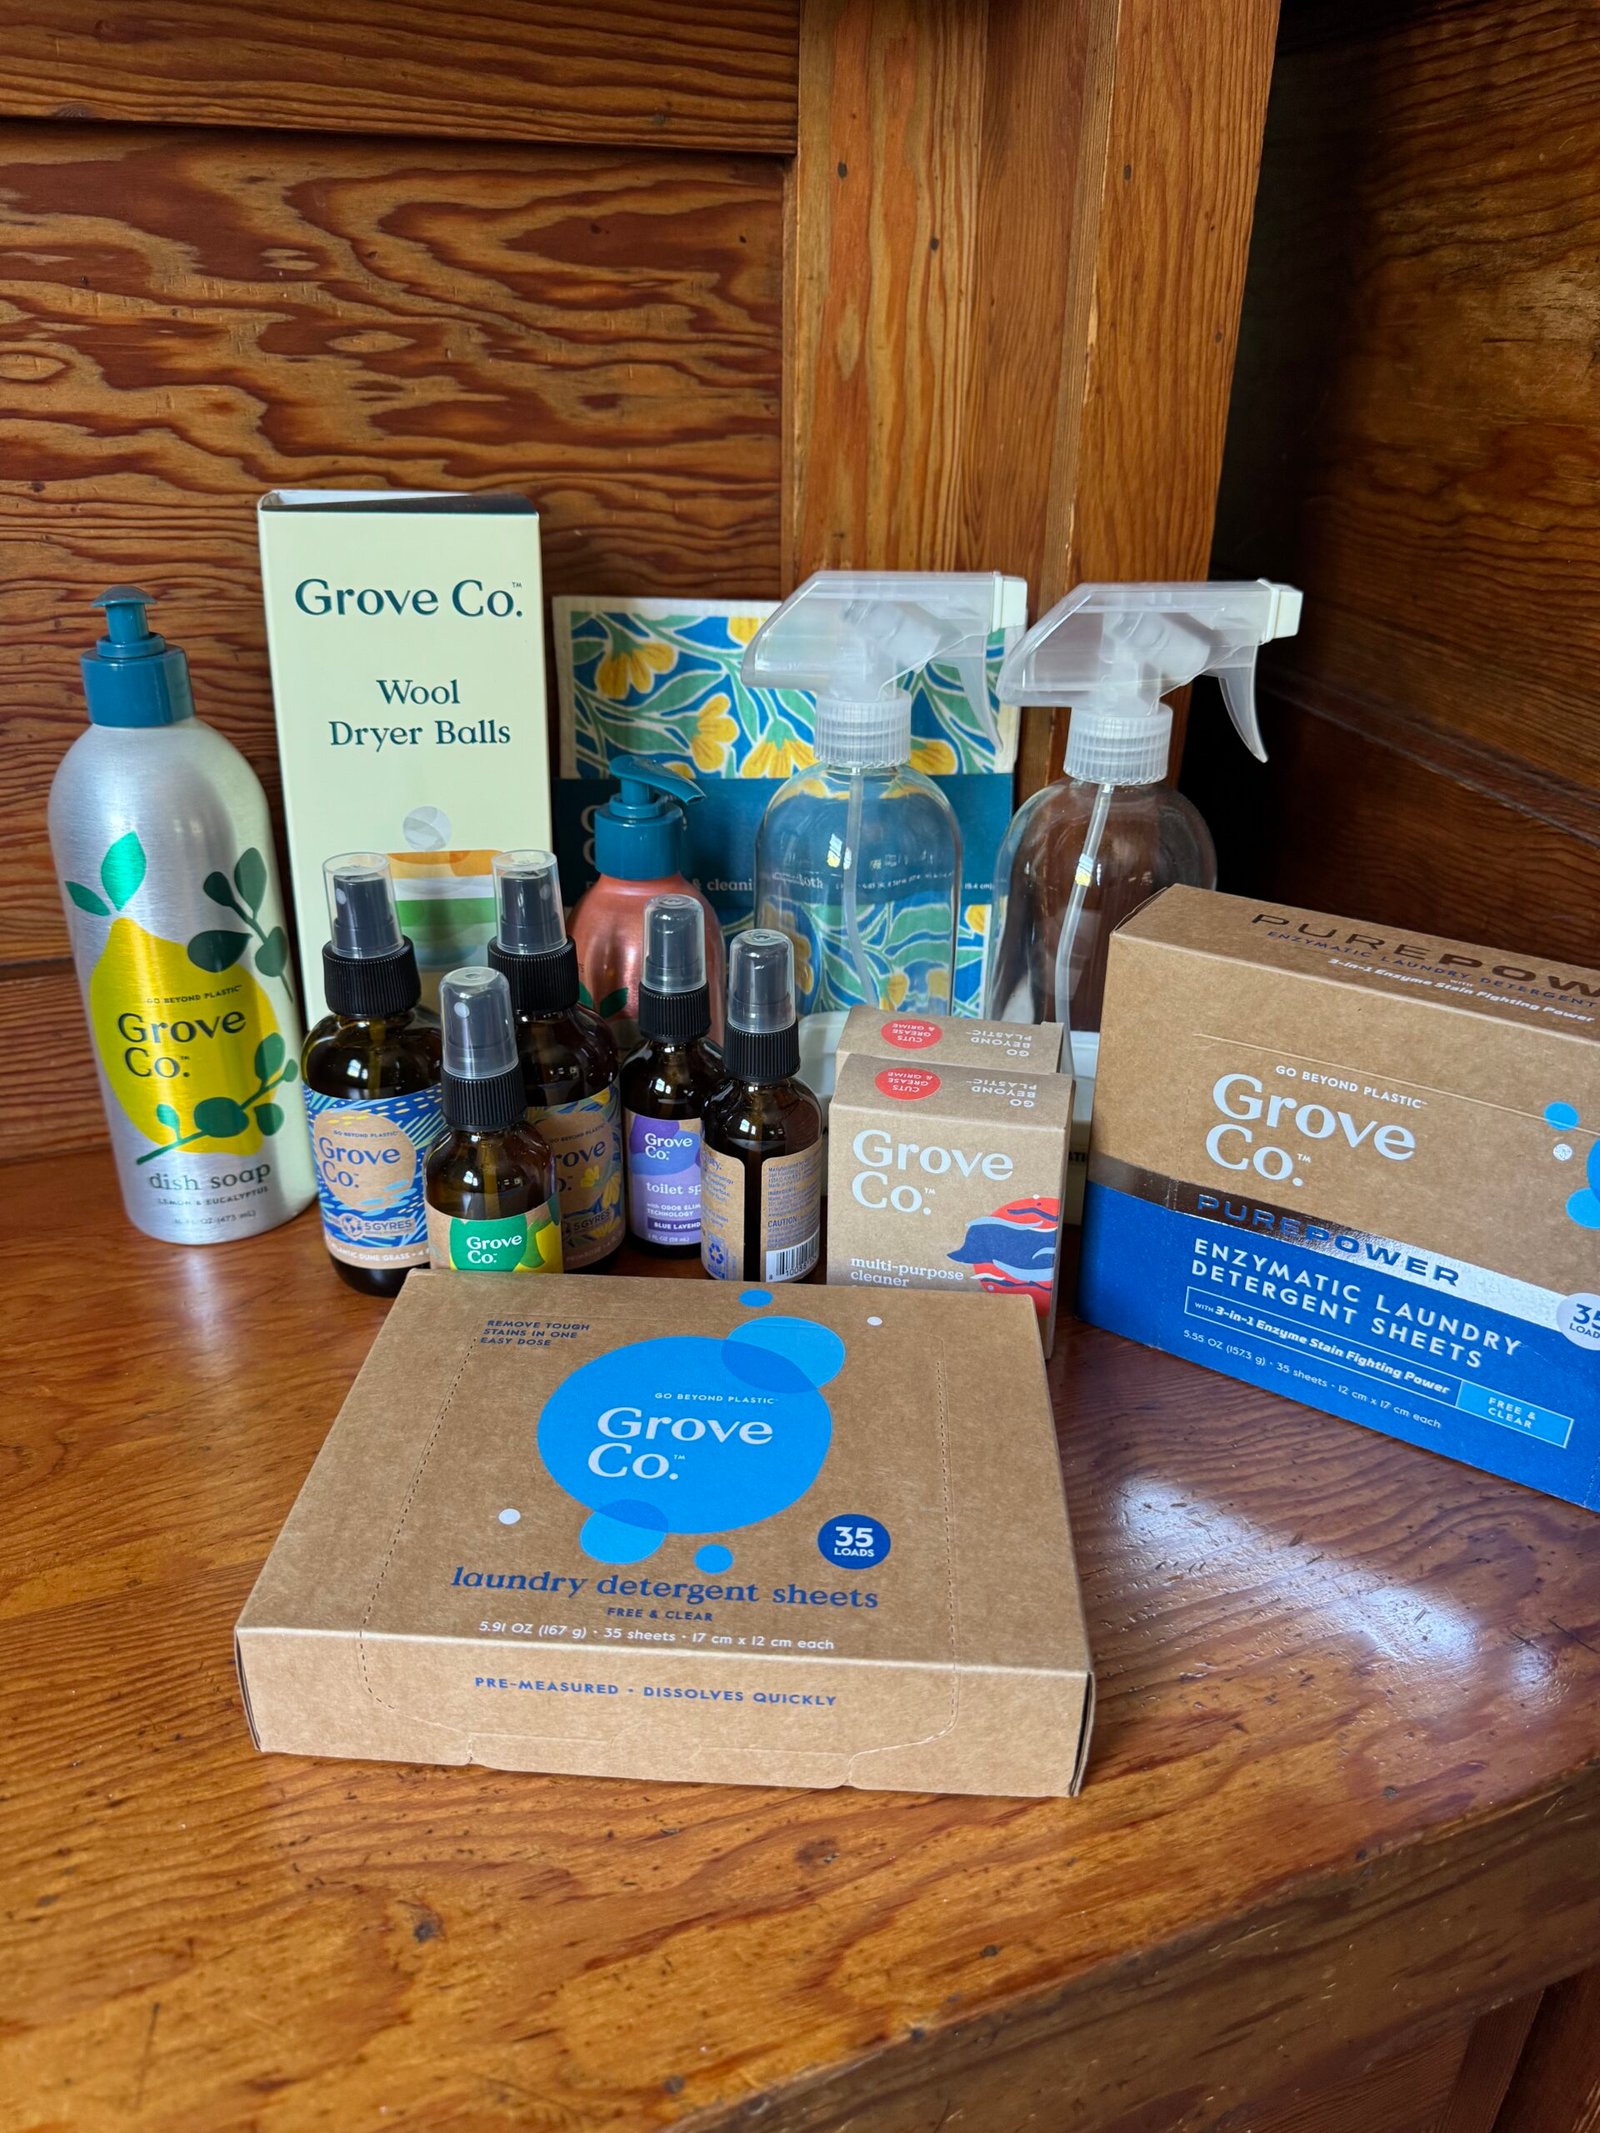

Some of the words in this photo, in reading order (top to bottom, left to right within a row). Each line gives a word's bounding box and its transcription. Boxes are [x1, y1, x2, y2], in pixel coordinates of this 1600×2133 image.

[295, 578, 439, 616] Grove
[375, 679, 461, 705] Wool
[328, 720, 424, 753] Dryer
[434, 719, 512, 745] Balls
[1266, 930, 1373, 959] ENZYMATIC
[1380, 955, 1471, 980] LAUNDRY
[1480, 976, 1598, 1009] DETERGENT
[163, 994, 201, 1005] BEYOND
[1327, 957, 1374, 975] 3-in-1
[1374, 968, 1433, 987] Enzyme
[1434, 982, 1475, 996] Stain
[1476, 990, 1540, 1012] Fighting
[1543, 1006, 1596, 1023] Power
[117, 1010, 247, 1044] Grove
[891, 1023, 925, 1031] GRIME
[891, 1029, 932, 1038] GREASE
[967, 1029, 1033, 1042] PLASTIC
[897, 1035, 924, 1043] CUTS
[970, 1036, 1031, 1049] BEYOND
[1006, 1049, 1030, 1057] GO
[887, 1071, 922, 1080] GRIME
[887, 1077, 930, 1087] GREASE
[967, 1077, 1038, 1091] PLASTIC
[1275, 1064, 1297, 1077] GO
[1301, 1071, 1359, 1093] BEYOND
[891, 1085, 920, 1094] CUTS
[971, 1085, 1036, 1099] BEYOND
[1009, 1098, 1035, 1108] GO
[1212, 1073, 1417, 1161] Grove
[644, 1132, 693, 1148] Grove
[318, 1136, 401, 1166] Grove
[554, 1139, 606, 1168] rove
[852, 1128, 1014, 1182] Grove
[150, 1172, 201, 1191] dish
[210, 1163, 271, 1189] soap
[205, 1186, 269, 1206] EUCALYPTUS
[646, 1181, 684, 1195] toilet
[646, 1208, 695, 1218] TECHNOLOGY
[653, 1221, 672, 1230] BLUE
[466, 1234, 523, 1250] Grove
[1197, 1193, 1460, 1288] PUREPOWER
[383, 1251, 411, 1262] GRASS
[850, 1256, 965, 1282] multi-purpose
[850, 1269, 910, 1288] cleaner
[1194, 1237, 1362, 1303] ENZYMATIC
[1375, 1294, 1522, 1356] LAUNDRY
[1191, 1259, 1358, 1325] DETERGENT
[1370, 1317, 1482, 1369] SHEETS
[483, 1328, 527, 1337] STAINS
[550, 1331, 578, 1339] ONE
[487, 1320, 541, 1329] REMOVE
[545, 1322, 591, 1331] TOUGH
[480, 1337, 513, 1345] EASY
[517, 1338, 552, 1346] DOSE
[1194, 1302, 1214, 1313] WITH
[1214, 1305, 1254, 1327] 3-in-1
[1255, 1320, 1308, 1345] Enzyme
[1308, 1337, 1345, 1358] Stain
[1345, 1350, 1402, 1380] Fighting
[1404, 1370, 1451, 1395] Power
[1183, 1328, 1205, 1344] 5.55
[1207, 1338, 1223, 1351] OZ
[1226, 1344, 1252, 1361] (157.3
[1254, 1356, 1267, 1367] g)
[1276, 1362, 1291, 1374] 35
[1292, 1369, 1328, 1388] sheets
[1337, 1384, 1349, 1396] 12
[1351, 1391, 1368, 1402] cm
[1370, 1397, 1377, 1405] x
[1379, 1399, 1391, 1410] 17
[1393, 1405, 1411, 1417] cm
[1412, 1412, 1442, 1429] each
[676, 1393, 724, 1402] BEYOND
[727, 1396, 775, 1405] PLASTIC
[1488, 1396, 1522, 1416] FREE
[1527, 1411, 1537, 1421] &
[597, 1406, 774, 1445] Grove
[1487, 1407, 1533, 1430] CLEAR
[834, 1526, 874, 1548] 35
[833, 1547, 875, 1558] LOADS
[450, 1566, 589, 1598] laundry
[596, 1574, 761, 1605] detergent
[772, 1583, 879, 1609] sheets
[606, 1607, 644, 1618] FREE
[648, 1609, 658, 1619] &
[664, 1610, 714, 1622] CLEAR
[479, 1620, 506, 1633] 5.91
[511, 1623, 534, 1634] OZ
[538, 1624, 568, 1638] (167
[572, 1626, 587, 1640] g)
[603, 1627, 623, 1639] 35
[627, 1629, 676, 1642] sheets
[692, 1632, 707, 1643] 17
[710, 1635, 733, 1646] cm
[737, 1637, 747, 1646] x
[751, 1635, 765, 1647] 12
[770, 1638, 792, 1648] cm
[796, 1639, 835, 1650] each
[474, 1676, 620, 1696] PRE-MEASURED
[643, 1686, 745, 1702] DISSOLVES
[752, 1691, 837, 1707] QUICKLY
